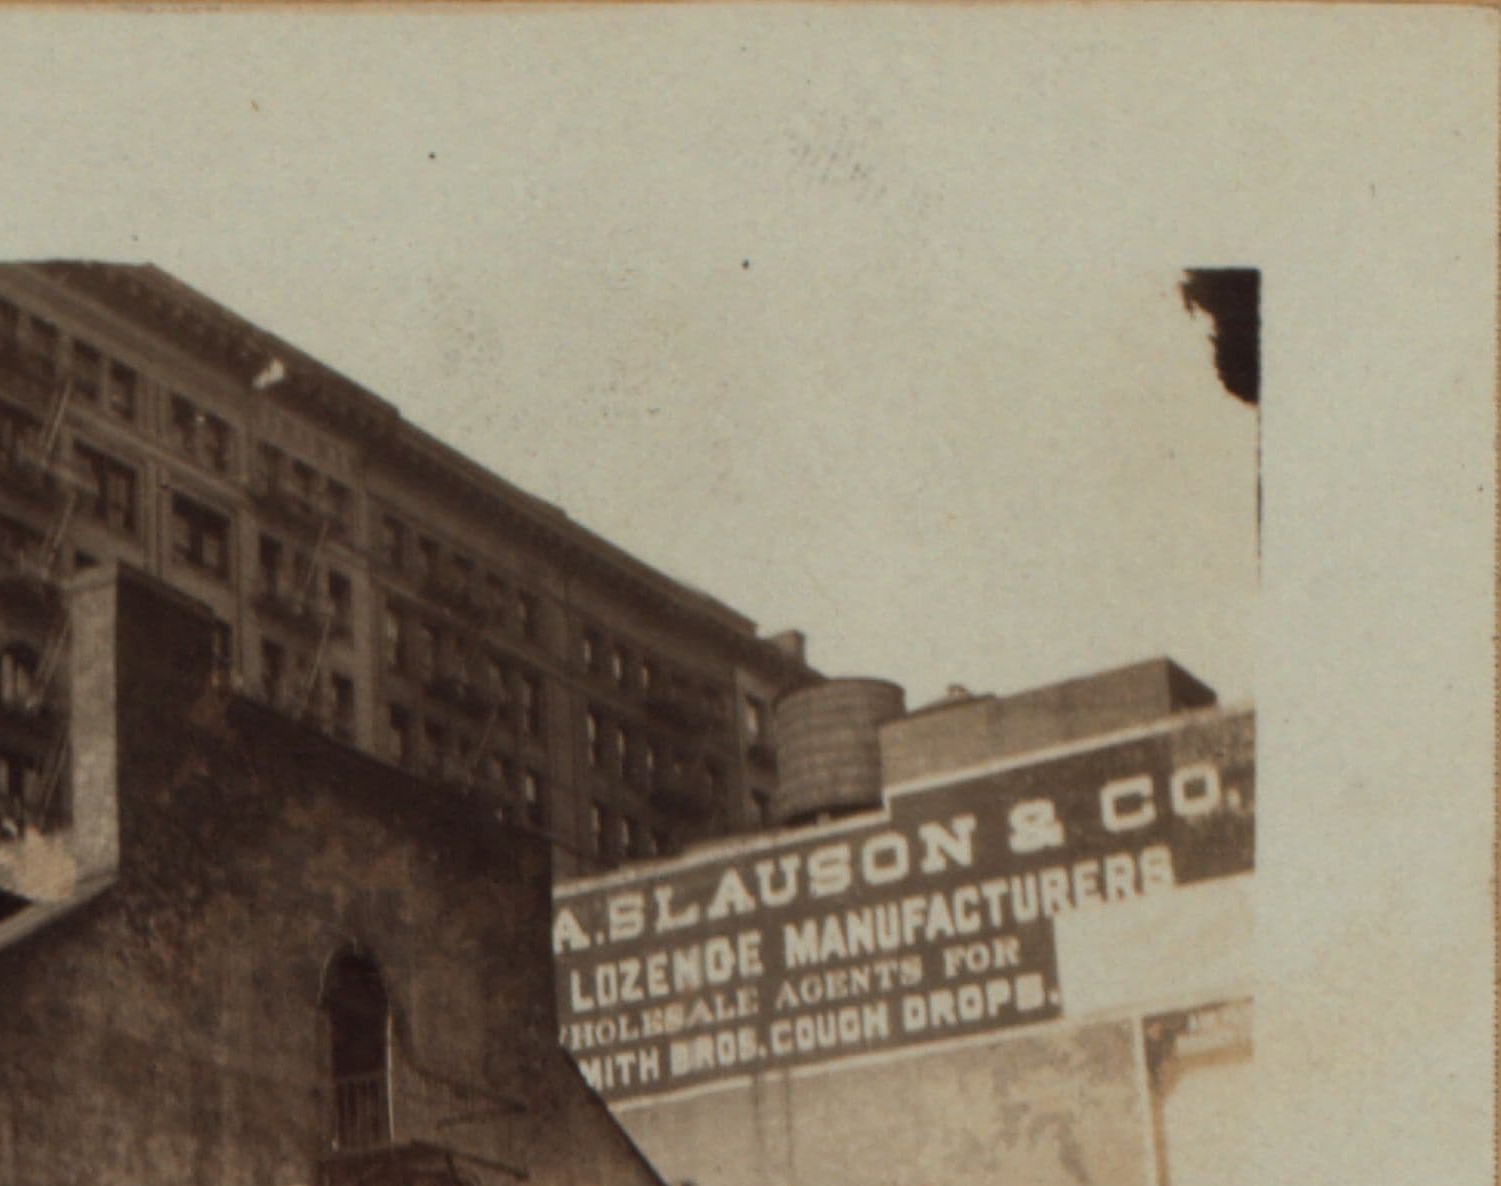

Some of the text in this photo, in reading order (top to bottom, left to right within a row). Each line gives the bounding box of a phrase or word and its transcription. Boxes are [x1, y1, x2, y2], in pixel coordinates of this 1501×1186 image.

[1008, 798, 1066, 854] &
[1100, 763, 1242, 833] CO.
[569, 844, 1175, 1013] LOZENGE MANUFACTURERS
[775, 954, 923, 1010] AGENTS
[944, 935, 1020, 979] FOR
[770, 1000, 890, 1056] COUGH
